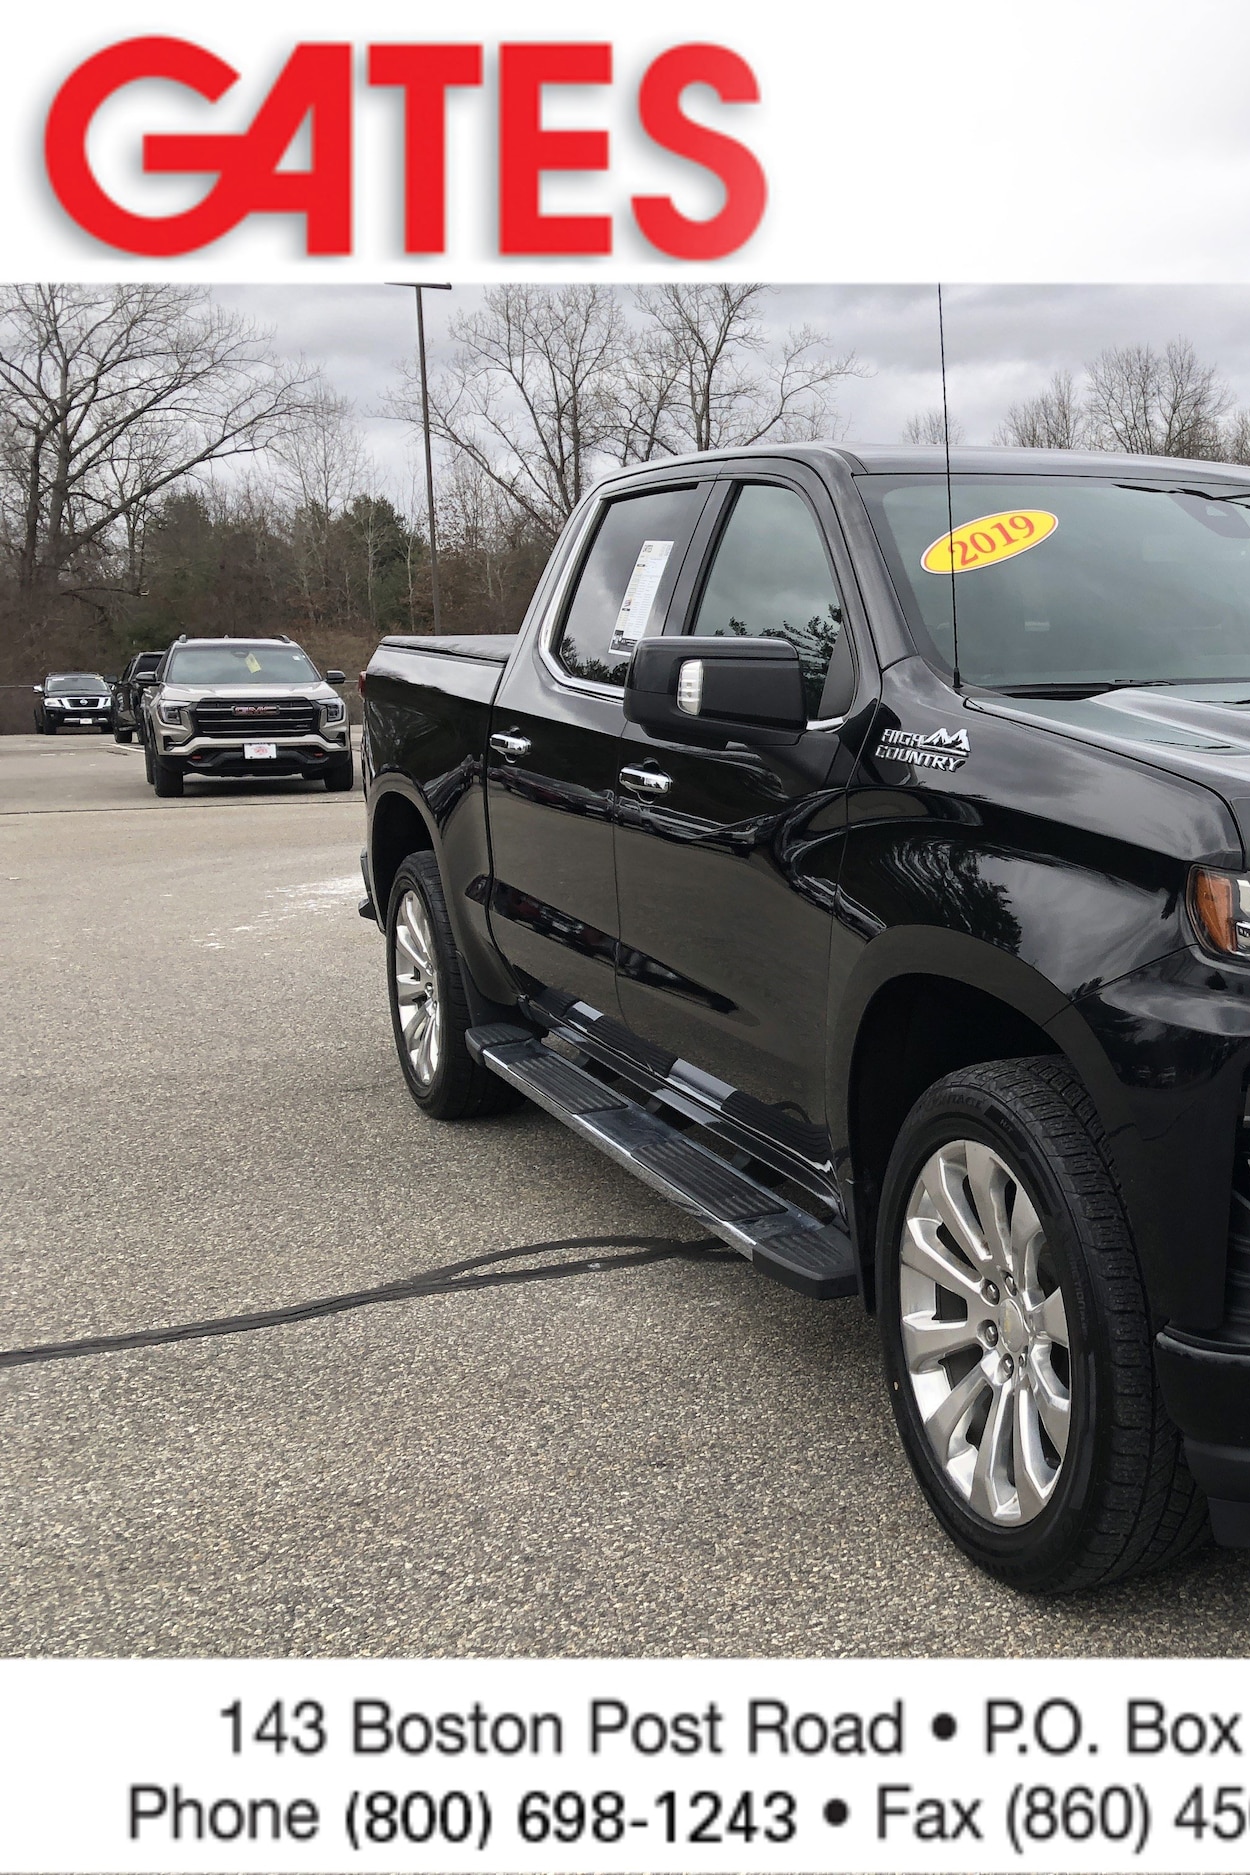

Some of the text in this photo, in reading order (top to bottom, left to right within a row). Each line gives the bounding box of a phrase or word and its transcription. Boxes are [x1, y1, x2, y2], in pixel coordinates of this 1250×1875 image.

[948, 515, 1035, 566] 2019
[881, 728, 925, 748] HIGH
[875, 744, 966, 773] COUNTRY
